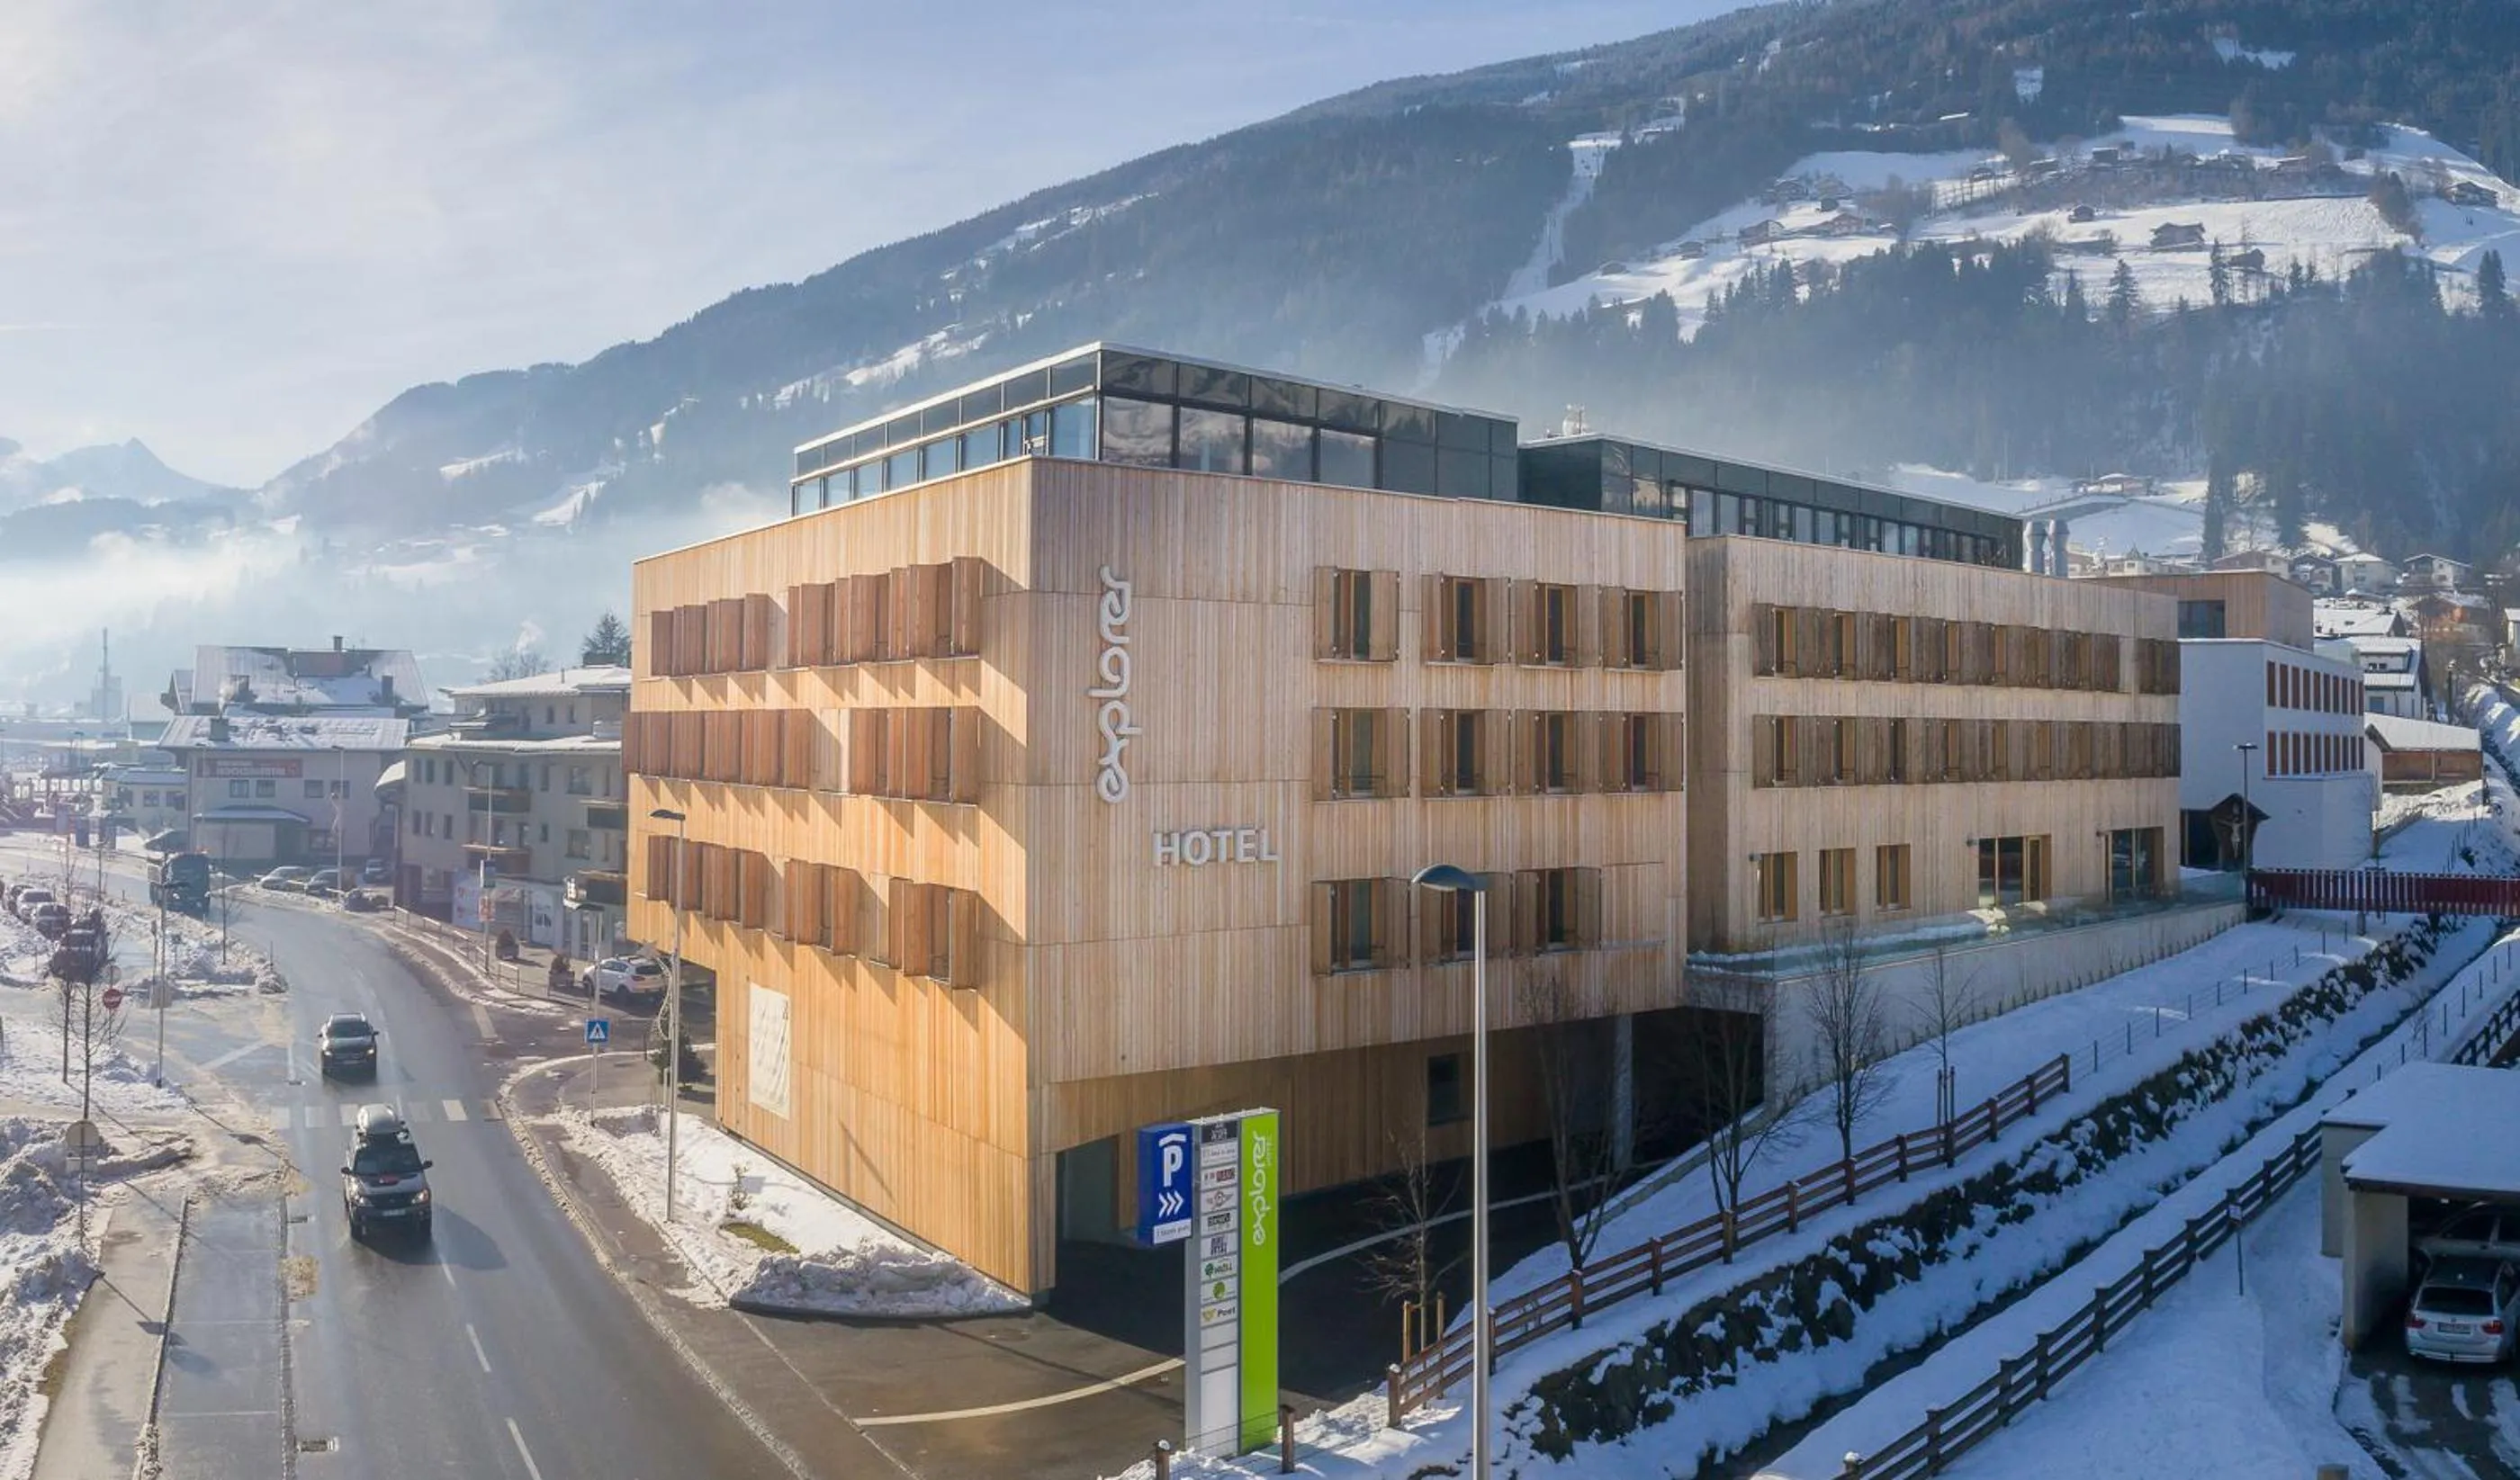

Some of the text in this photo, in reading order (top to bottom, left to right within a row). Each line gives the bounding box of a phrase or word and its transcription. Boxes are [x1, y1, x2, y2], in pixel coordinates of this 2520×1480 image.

[1085, 565, 1143, 804] explorer
[1152, 829, 1280, 867] HOTEL
[1249, 1131, 1271, 1246] explorer
